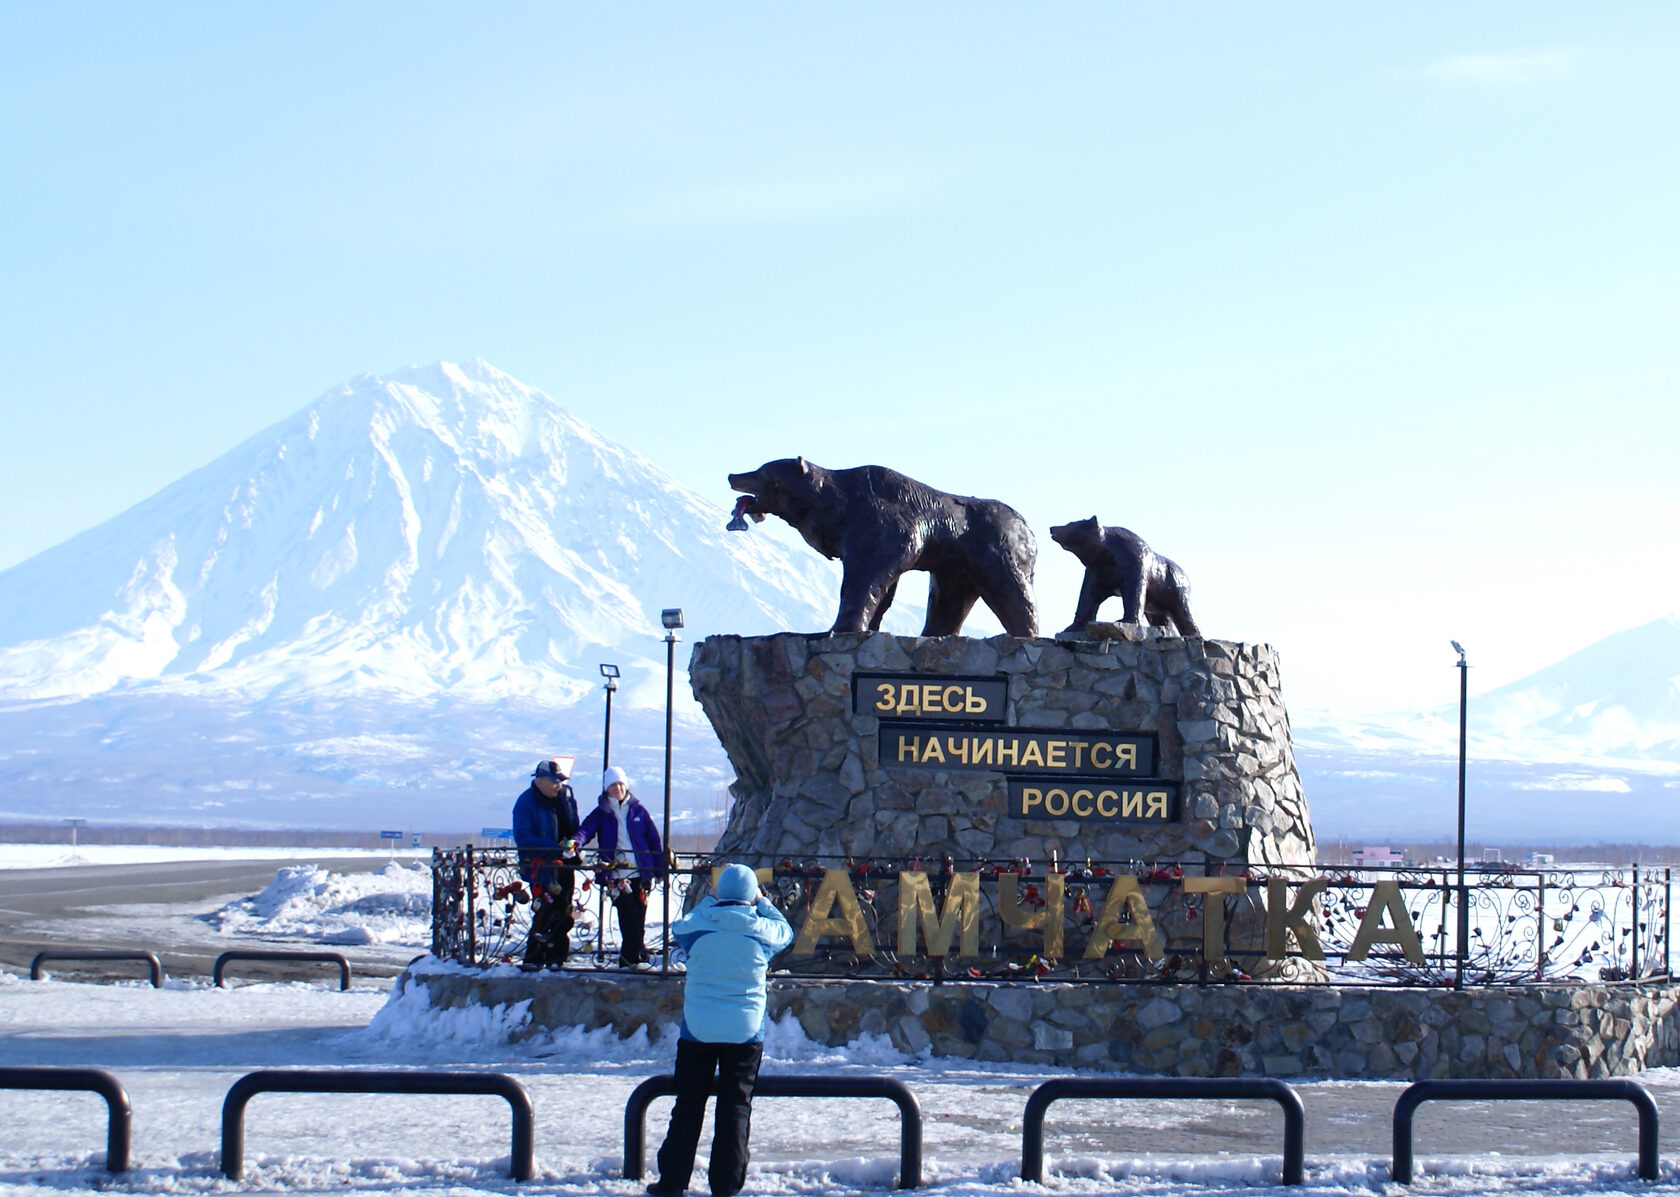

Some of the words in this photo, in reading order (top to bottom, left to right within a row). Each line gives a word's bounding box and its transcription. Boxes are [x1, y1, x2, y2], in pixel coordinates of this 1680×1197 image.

[876, 683, 987, 716] ЗДЕСЬ
[898, 736, 1137, 770] НАЧИНАЕТСЯ
[1022, 788, 1167, 818] РОССИЯ
[711, 866, 1425, 963] АМЧАТКА
